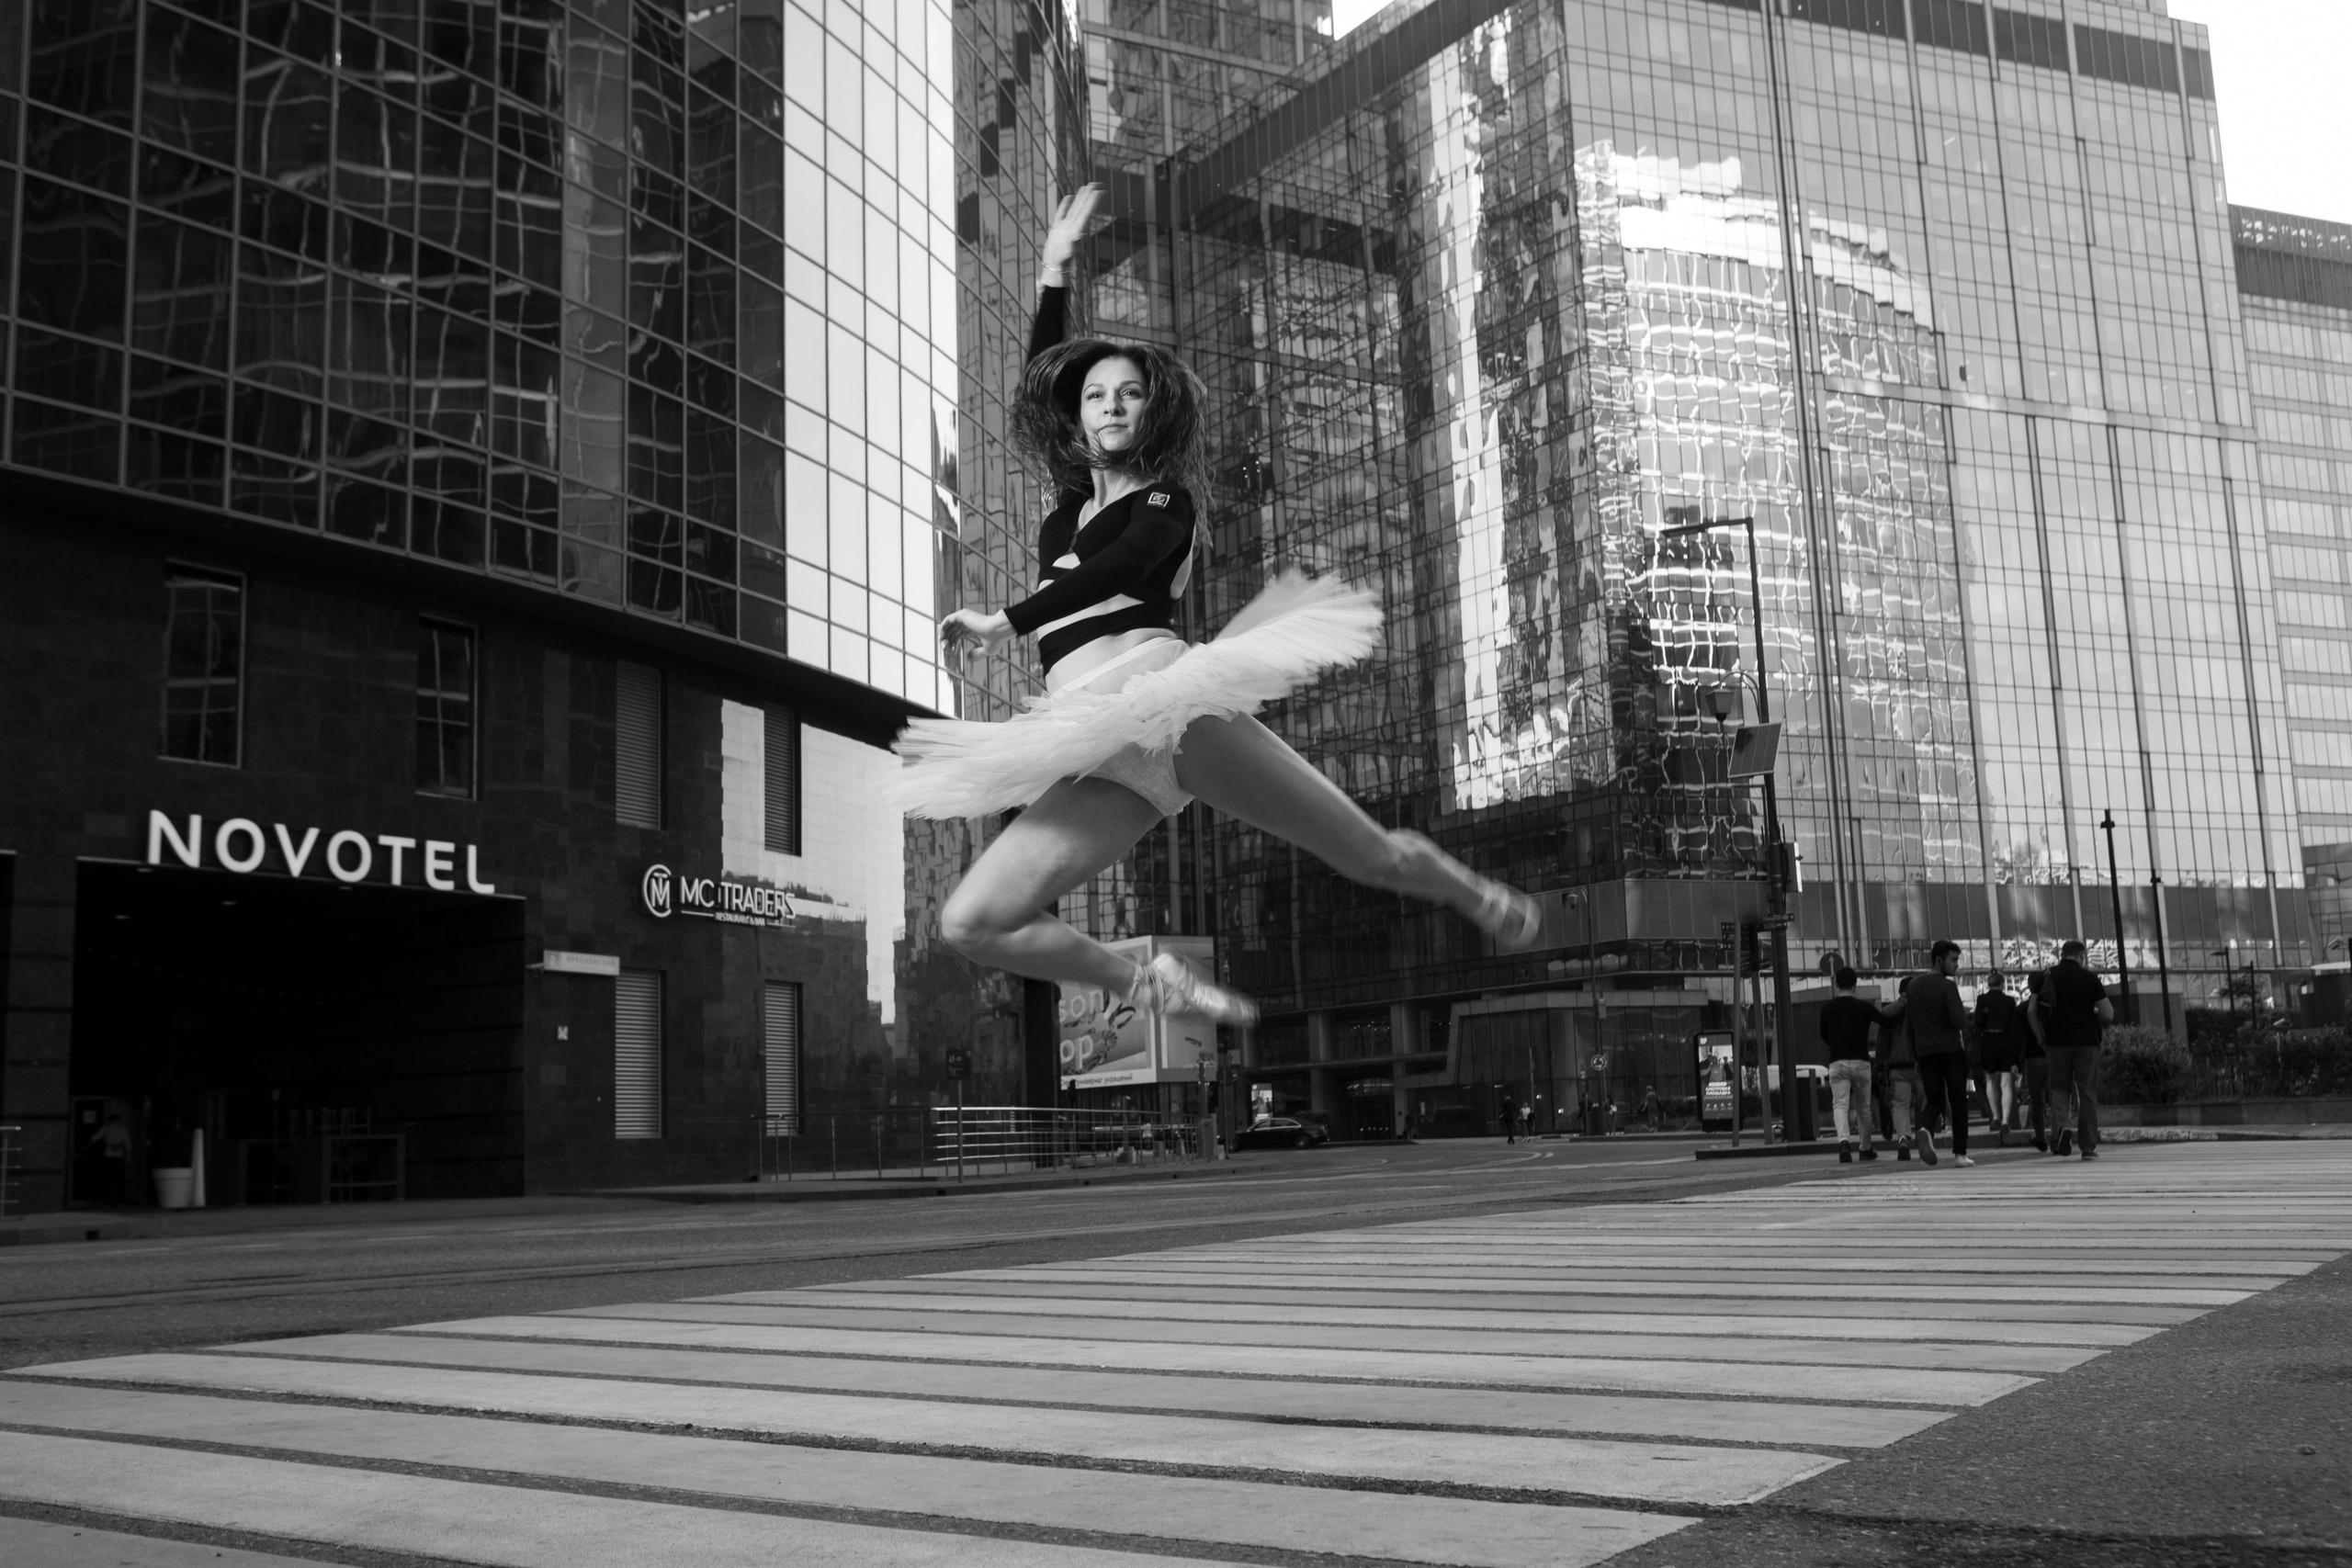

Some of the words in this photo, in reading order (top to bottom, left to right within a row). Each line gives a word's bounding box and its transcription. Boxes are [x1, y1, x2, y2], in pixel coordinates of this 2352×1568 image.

[147, 809, 495, 895] NOVOTEL
[680, 875, 715, 908] MC
[719, 881, 796, 919] TRADERS
[716, 911, 749, 925] RESTAURANT
[754, 916, 766, 927] BAR
